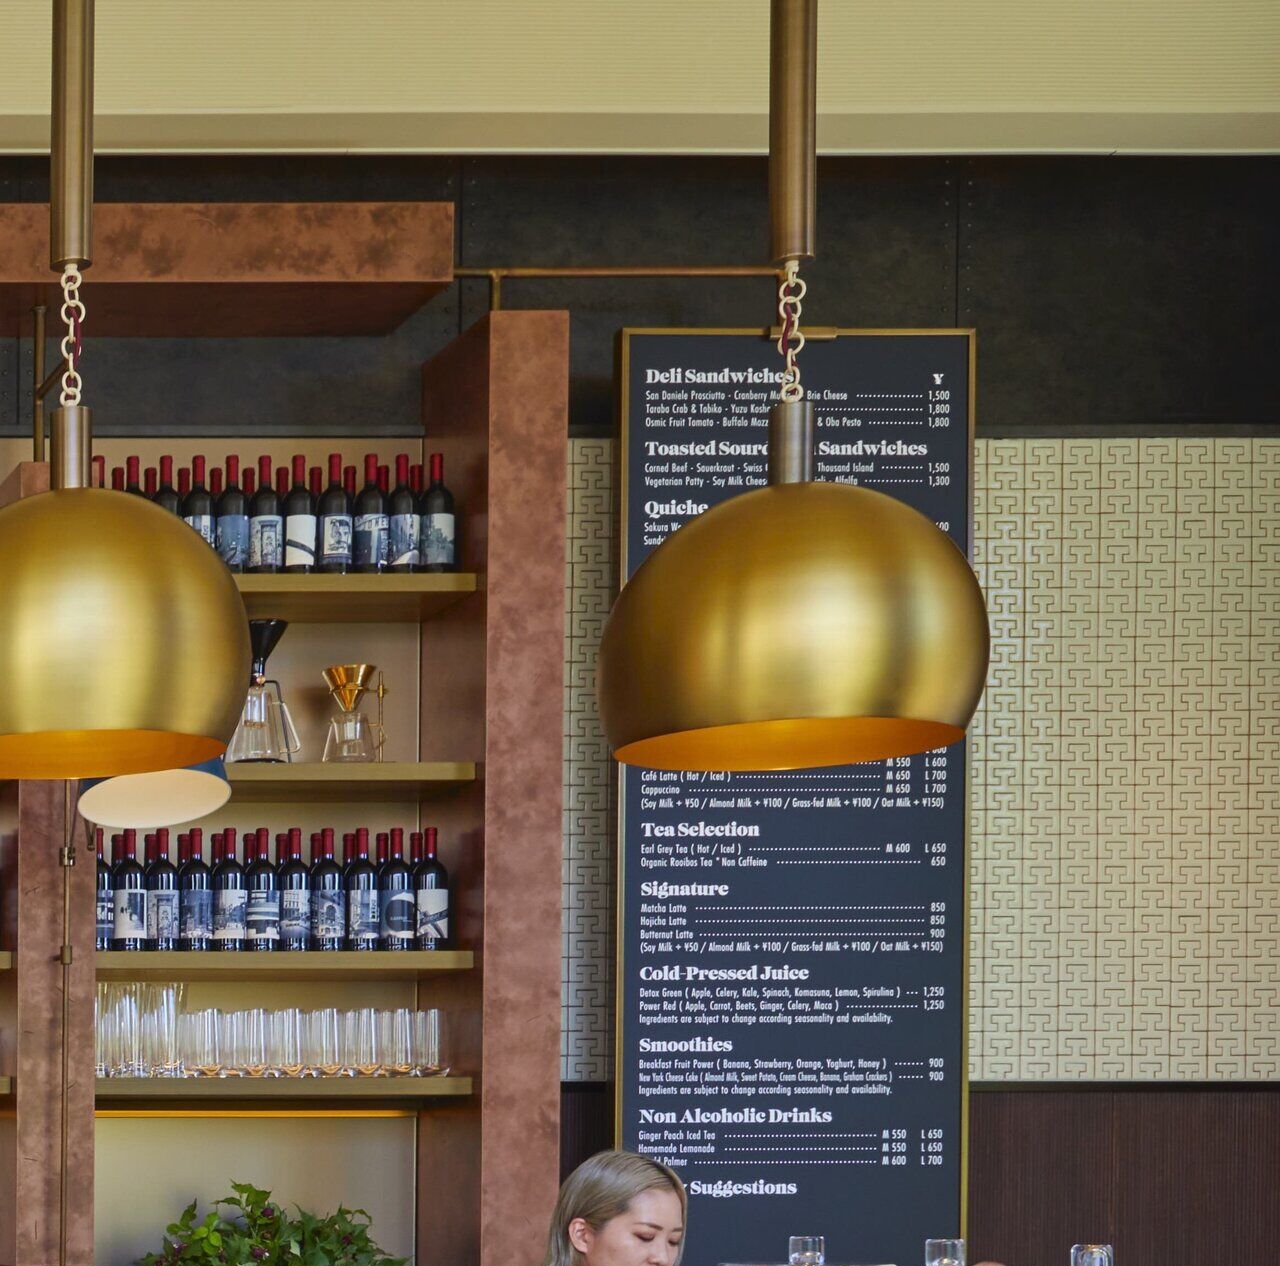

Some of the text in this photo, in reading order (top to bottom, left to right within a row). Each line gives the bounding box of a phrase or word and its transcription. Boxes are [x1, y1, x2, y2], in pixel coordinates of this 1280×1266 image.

[646, 368, 795, 384] Deli Sandwiches
[646, 390, 659, 401] San
[662, 390, 688, 401] Daniele
[691, 390, 725, 401] Prosciutto
[734, 390, 767, 402] Cranberry
[807, 390, 820, 401] Brie
[824, 390, 848, 401] Cheese
[929, 391, 950, 401] 1,500
[646, 404, 950, 414] Taraba Crab & Tobiko Yuzu 1,800
[646, 417, 666, 427] Osmic
[669, 417, 685, 427] Fruit
[688, 417, 713, 427] Tomato
[723, 417, 748, 427] Buffalo
[817, 417, 823, 427] &
[826, 417, 839, 427] Oba
[842, 417, 861, 427] Pesto
[929, 417, 950, 428] 1,800
[645, 440, 716, 456] Toasted
[819, 440, 928, 456] Sandwiches
[645, 462, 950, 473] Corned Beef Sauerkraut Swiss Thousand Island 1,500
[645, 476, 682, 488] Vegetarian
[686, 476, 704, 488] Patty
[713, 476, 725, 488] Soy
[728, 476, 743, 486] Milk
[929, 476, 950, 486] 1,300
[644, 500, 709, 519] Quiche
[644, 522, 668, 532] Sakura
[896, 758, 946, 767] 550 600
[641, 771, 946, 781] Café Latte Hot Iced 650 700
[641, 784, 946, 796] Cappuccino 650 700
[641, 821, 760, 837] Tea Selection
[641, 843, 946, 856] Earl Grey Tea Hot Iced 600 650
[641, 856, 945, 869] Organic Rooibos Tea Caffeine 650
[641, 881, 729, 899] Signature
[641, 903, 945, 913] Matcha Latte 850
[641, 915, 945, 928] Hojicha Latte 850
[640, 929, 945, 940] Butternut Latte 900
[640, 965, 809, 981] Cold-Pressed Juice
[640, 988, 659, 998] Detox
[662, 988, 682, 998] Green
[691, 988, 713, 1000] Apple,
[716, 988, 739, 1000] Celery,
[742, 988, 759, 998] Kale,
[762, 988, 791, 1000] Spinach,
[835, 988, 860, 998] Lemon,
[863, 988, 894, 998] Spirulina
[924, 987, 944, 997] 1,250
[640, 1000, 944, 1013] Power Red Apple, Carrot, Beets, Ginger, Celery, Maca 1,250
[639, 1037, 733, 1052] Smoothies
[639, 1059, 672, 1069] Breakfast
[675, 1059, 690, 1069] Fruit
[693, 1059, 714, 1069] Power
[723, 1059, 751, 1069] Banana,
[796, 1059, 823, 1071] Orange,
[858, 1059, 880, 1071] Honey
[929, 1058, 944, 1068] 900
[639, 1108, 832, 1124] Non Alcoholic Drinks
[639, 1129, 942, 1142] Ginger Peach Iced Tea 550 650
[639, 1143, 942, 1153] Homemade Lemonade 550 650
[664, 1156, 942, 1166] Palmer 600 700
[690, 1179, 797, 1198] Suggestions
